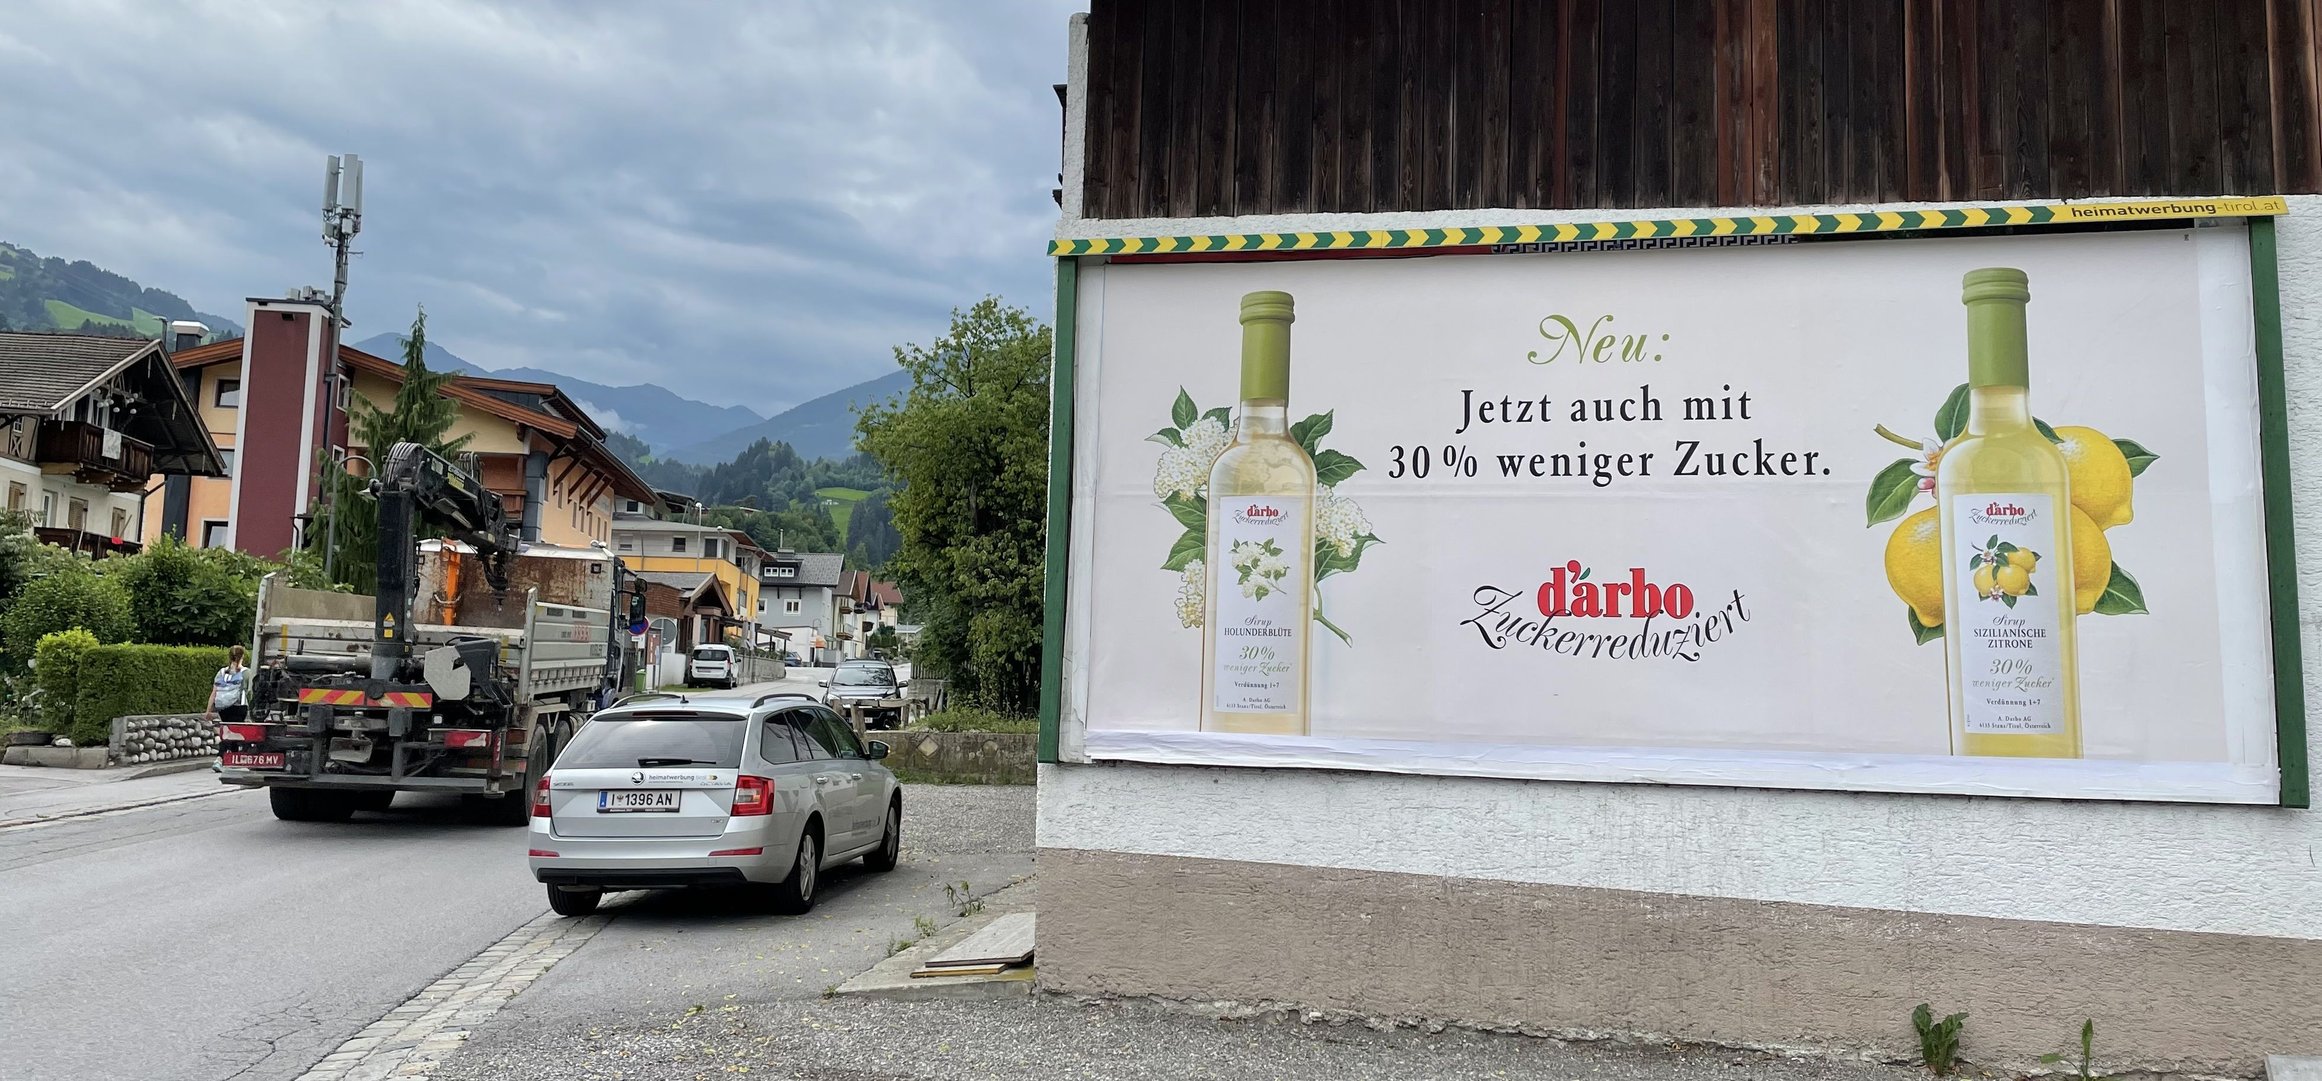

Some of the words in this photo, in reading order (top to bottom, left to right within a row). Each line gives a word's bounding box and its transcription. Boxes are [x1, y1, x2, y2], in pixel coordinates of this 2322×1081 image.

[2071, 199, 2280, 218] heimatwerbung-tirol.at
[1527, 314, 1671, 365] Neu:
[1456, 389, 1552, 435] Jetzt
[1571, 384, 1663, 422] auch
[1683, 384, 1752, 421] mit
[1496, 440, 1654, 488] weniger
[1673, 437, 1831, 477] Zucker.
[1969, 508, 2038, 526] Zuckerreduziert
[1244, 615, 1272, 628] Sirup
[1459, 584, 1752, 662] Zuckerreduziert
[1993, 614, 2026, 628] Sirup
[1224, 627, 1292, 637] HOLUNDERBLÜTE
[1974, 628, 2047, 638] SIZILIANISCHE
[1988, 639, 2033, 649] ZITRONE
[1223, 663, 1258, 675] weniger
[1972, 678, 2012, 691] weniger
[1986, 698, 2027, 707] Verdünnung
[648, 774, 695, 782] heimatwerbung
[624, 793, 653, 806] 1396
[656, 793, 672, 806] AN
